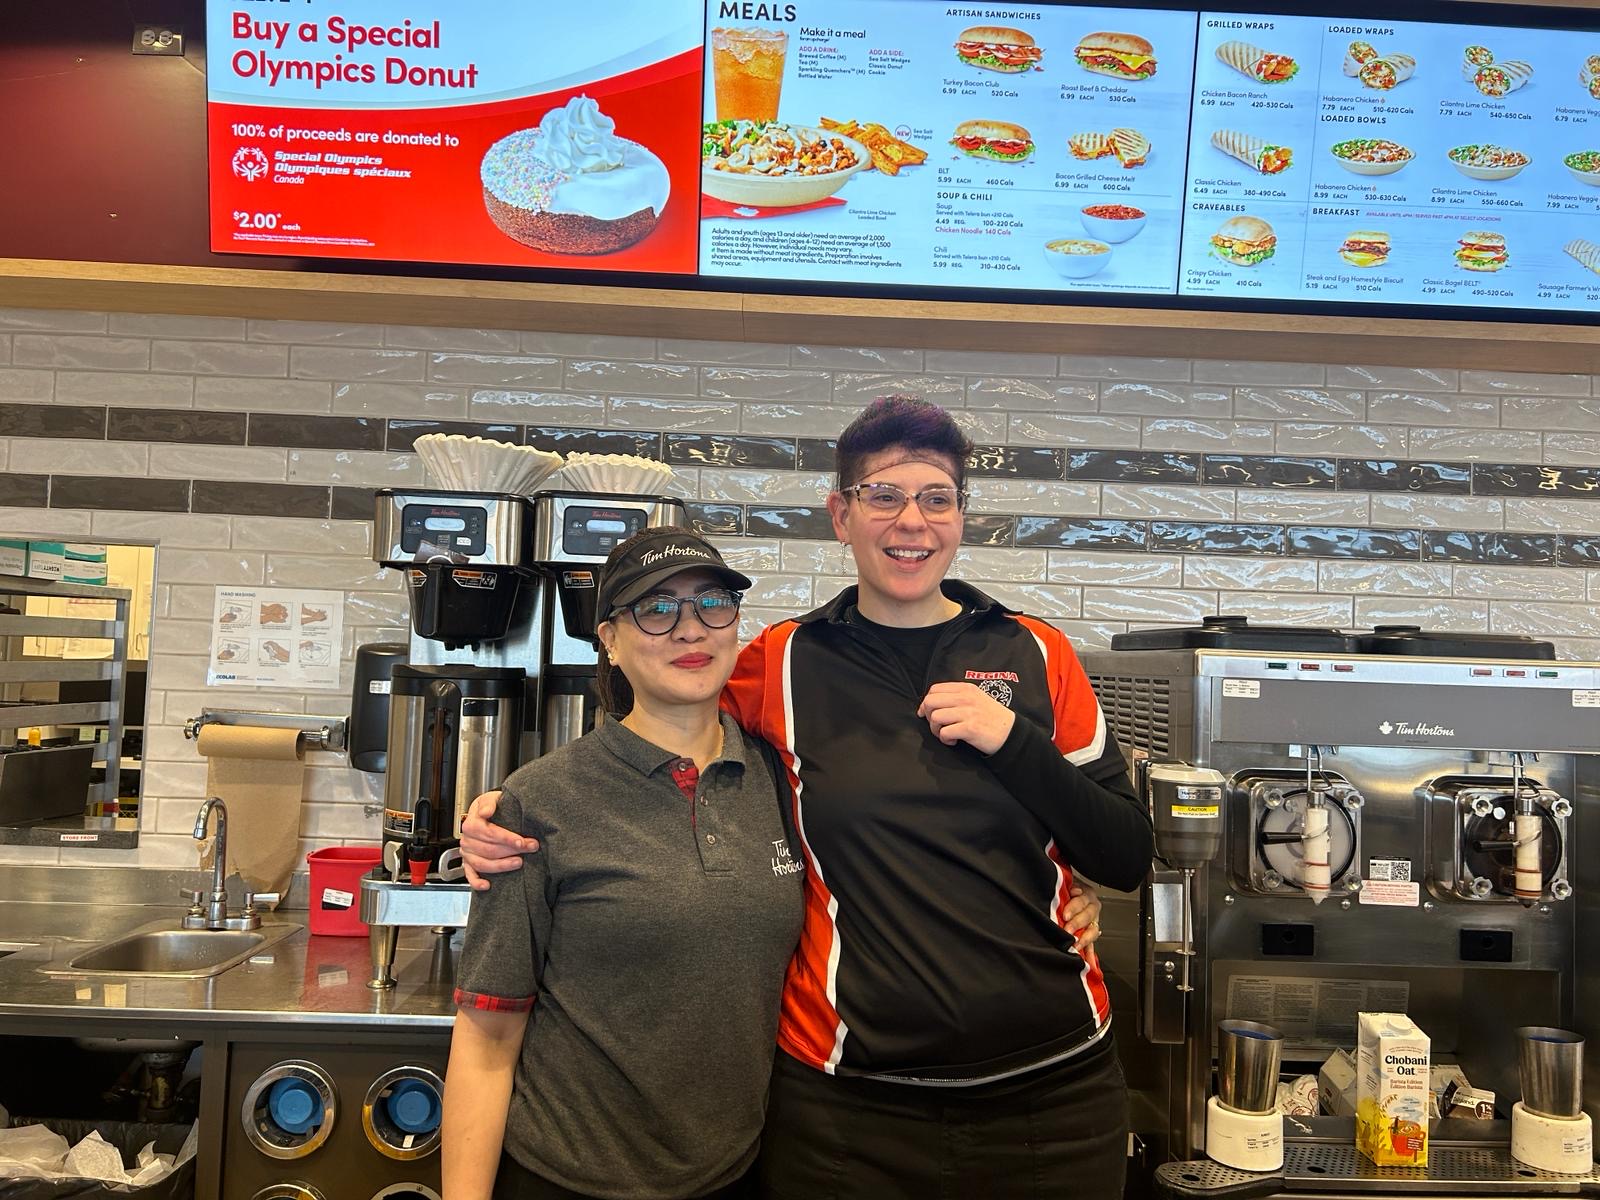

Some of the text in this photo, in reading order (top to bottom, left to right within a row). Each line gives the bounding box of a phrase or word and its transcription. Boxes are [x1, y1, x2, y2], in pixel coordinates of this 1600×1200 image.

[720, 2, 797, 22] MEALS
[946, 9, 1041, 20] ARTISAN SANDWICHES
[1245, 22, 1274, 30] WRAPS
[1329, 26, 1362, 34] LOADED
[232, 12, 440, 52] Buy a Special
[800, 28, 825, 38] Make
[828, 29, 833, 37] it
[843, 29, 866, 38] meal
[232, 50, 478, 89] Olympics Donut
[943, 79, 962, 87] Turkey
[1321, 115, 1354, 123] LOADED
[232, 124, 459, 147] 100% of proceeds are donated to
[274, 151, 382, 166] Special Olympics
[274, 163, 412, 178] Olympiques spéciaux
[274, 175, 304, 184] Canada
[1313, 208, 1360, 216] BREAKFAST
[1188, 270, 1206, 278] Crispy
[641, 544, 710, 566] Tim Hortons
[965, 670, 1019, 682] REGINA
[1396, 723, 1454, 736] Tim Hortons
[1385, 1055, 1427, 1065] Chobani
[1397, 1066, 1415, 1075] Oat
